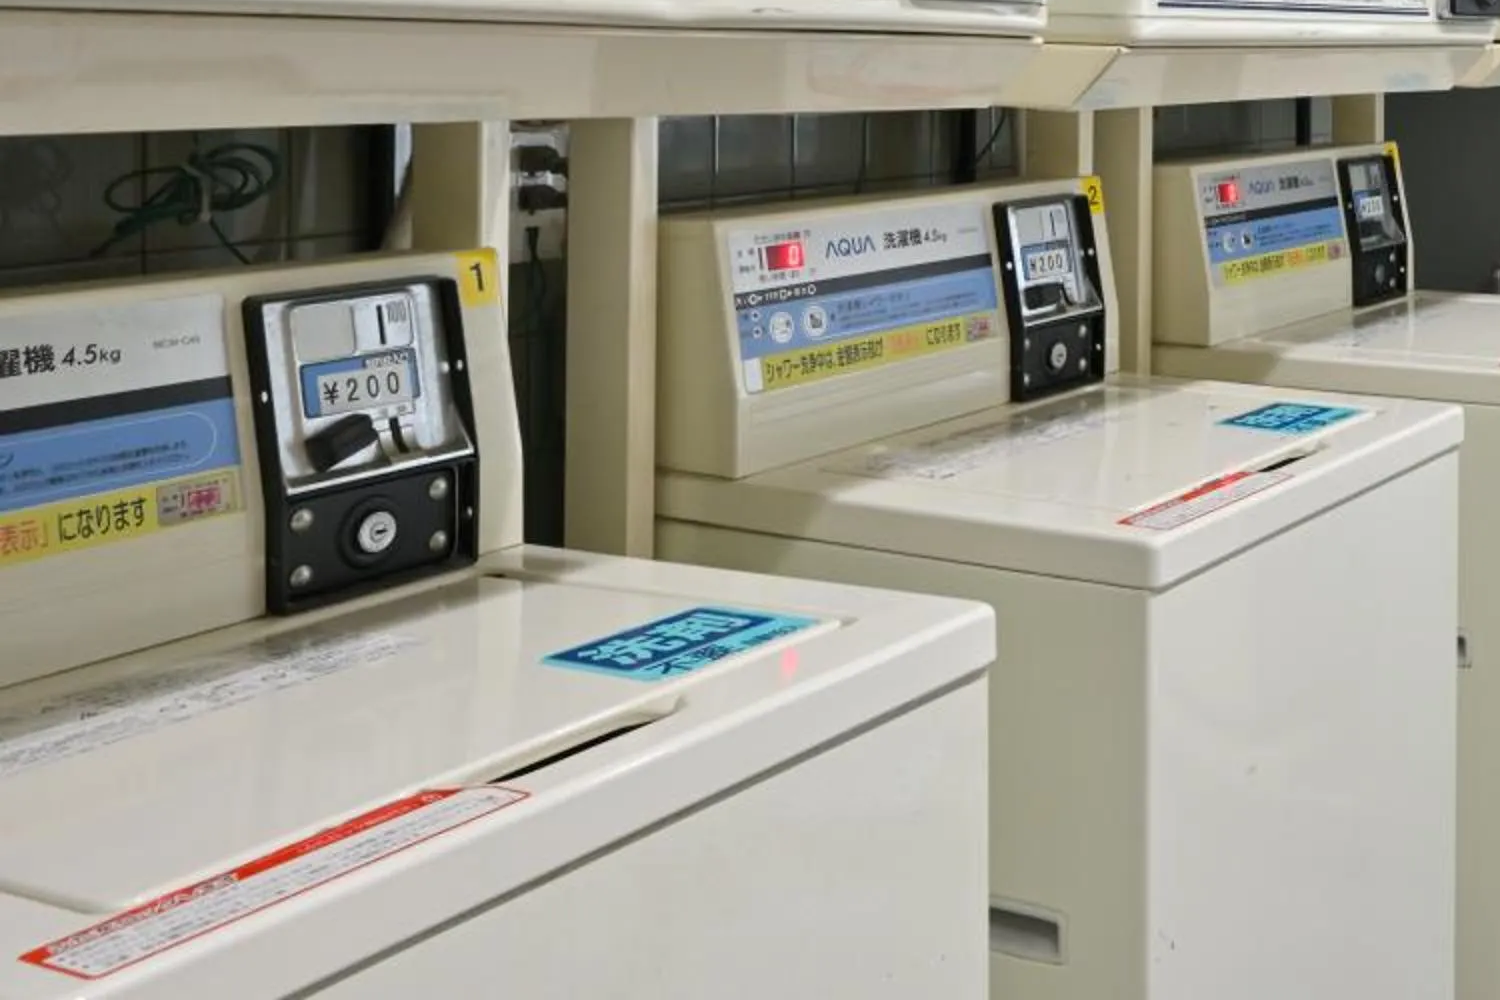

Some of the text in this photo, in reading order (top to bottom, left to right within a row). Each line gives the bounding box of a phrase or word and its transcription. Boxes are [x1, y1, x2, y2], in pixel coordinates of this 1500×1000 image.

[1088, 186, 1100, 206] 2
[787, 245, 800, 266] 0
[826, 234, 877, 260] AQUA
[883, 228, 923, 250] 洗濯機
[469, 263, 484, 292] 1
[62, 343, 121, 367] 4.5kg
[323, 371, 400, 405] ¥200
[57, 496, 147, 543] になります
[577, 612, 752, 665] 洗剤
